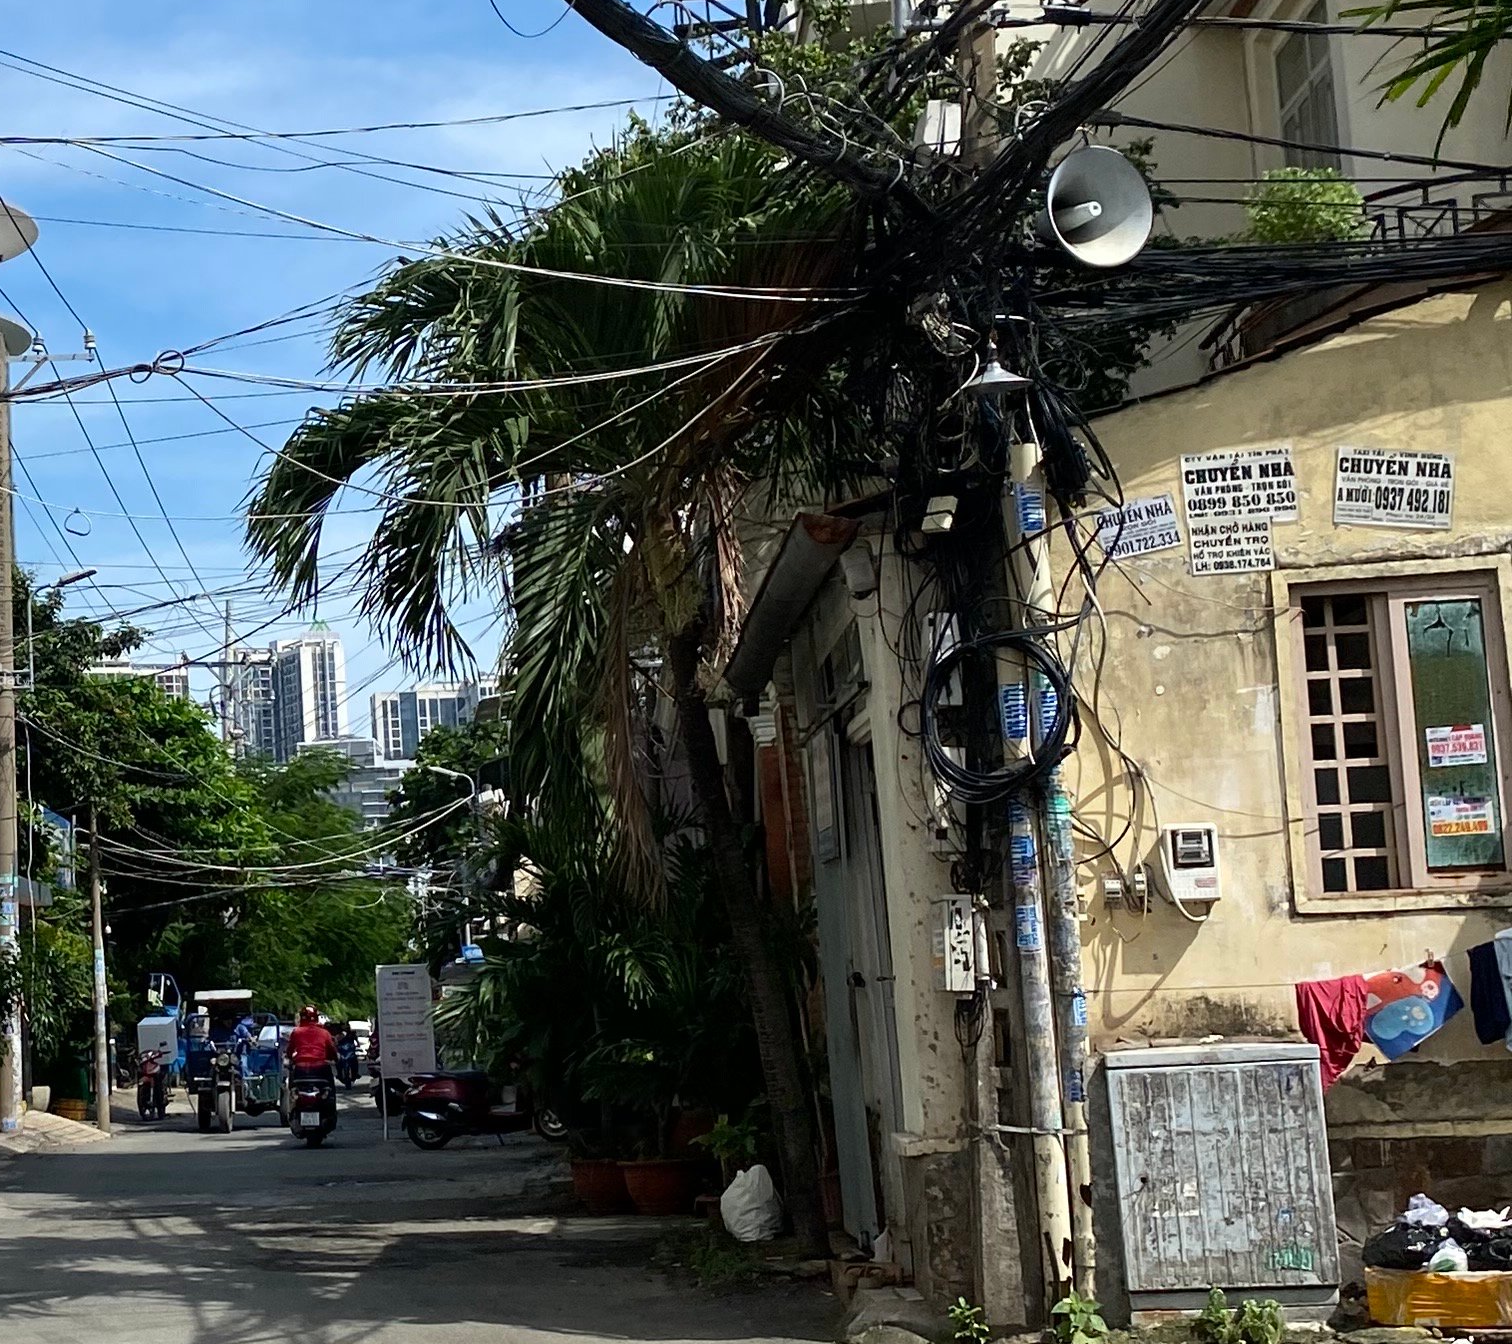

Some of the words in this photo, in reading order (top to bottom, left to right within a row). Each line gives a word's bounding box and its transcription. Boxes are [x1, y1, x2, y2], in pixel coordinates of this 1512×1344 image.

[1184, 459, 1253, 485] CHUYỂN
[1259, 457, 1295, 478] NHÀ
[1339, 453, 1410, 477] CHUYỂN
[1415, 457, 1452, 479] NHÀ
[1144, 498, 1173, 520] NHÀ
[1188, 496, 1227, 511] 0899
[1232, 494, 1261, 508] 850
[1266, 491, 1296, 505] 850
[1191, 524, 1217, 536] NHẬN
[1219, 521, 1239, 534] CHỞ
[1241, 522, 1268, 533] HÀNG
[1193, 534, 1242, 549] CHUYỂN
[1244, 535, 1269, 546] TRỌ
